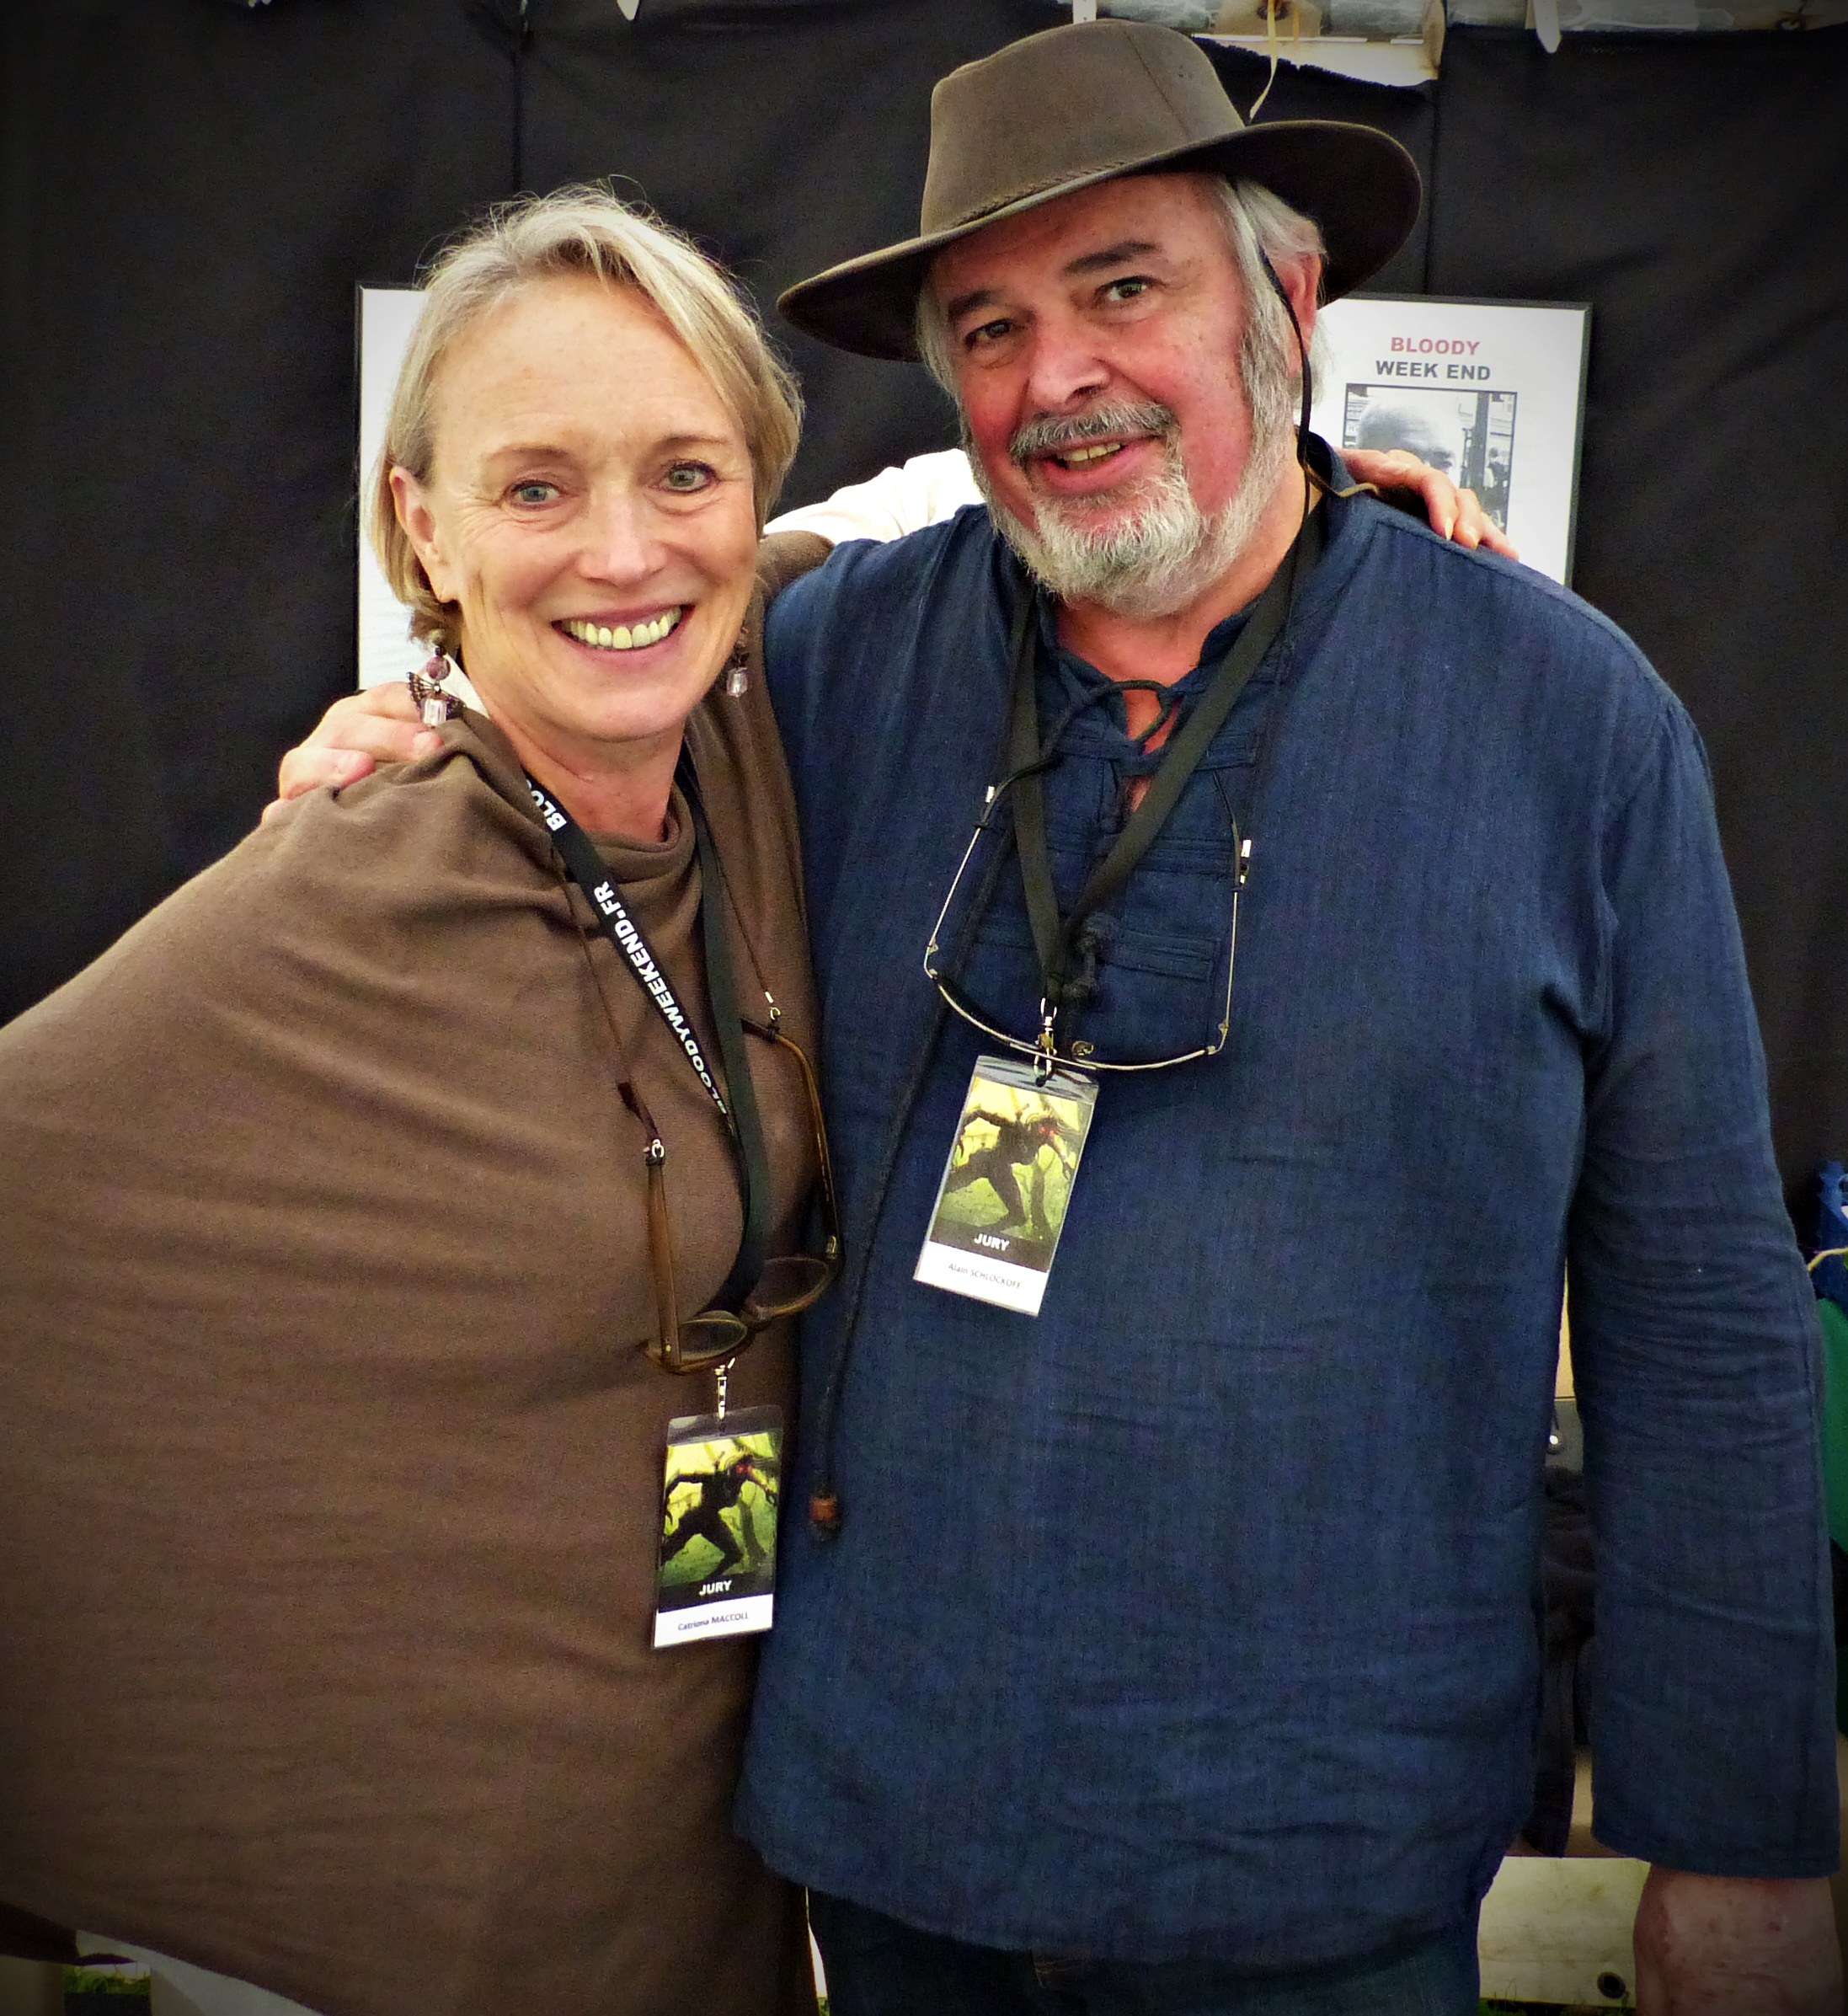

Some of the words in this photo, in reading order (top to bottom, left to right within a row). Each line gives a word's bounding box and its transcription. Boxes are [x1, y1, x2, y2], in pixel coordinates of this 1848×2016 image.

[1391, 337, 1481, 356] BLOODY
[1375, 361, 1439, 378] WEEK
[1446, 364, 1491, 381] END
[526, 779, 567, 831] BLO
[974, 1233, 1010, 1251] JURY
[948, 1263, 968, 1275] Alain
[970, 1269, 1022, 1289] SCHLOCKOFF
[698, 1580, 733, 1596] JURY
[677, 1618, 709, 1631] Catriona
[711, 1612, 749, 1624] MACCOLL
